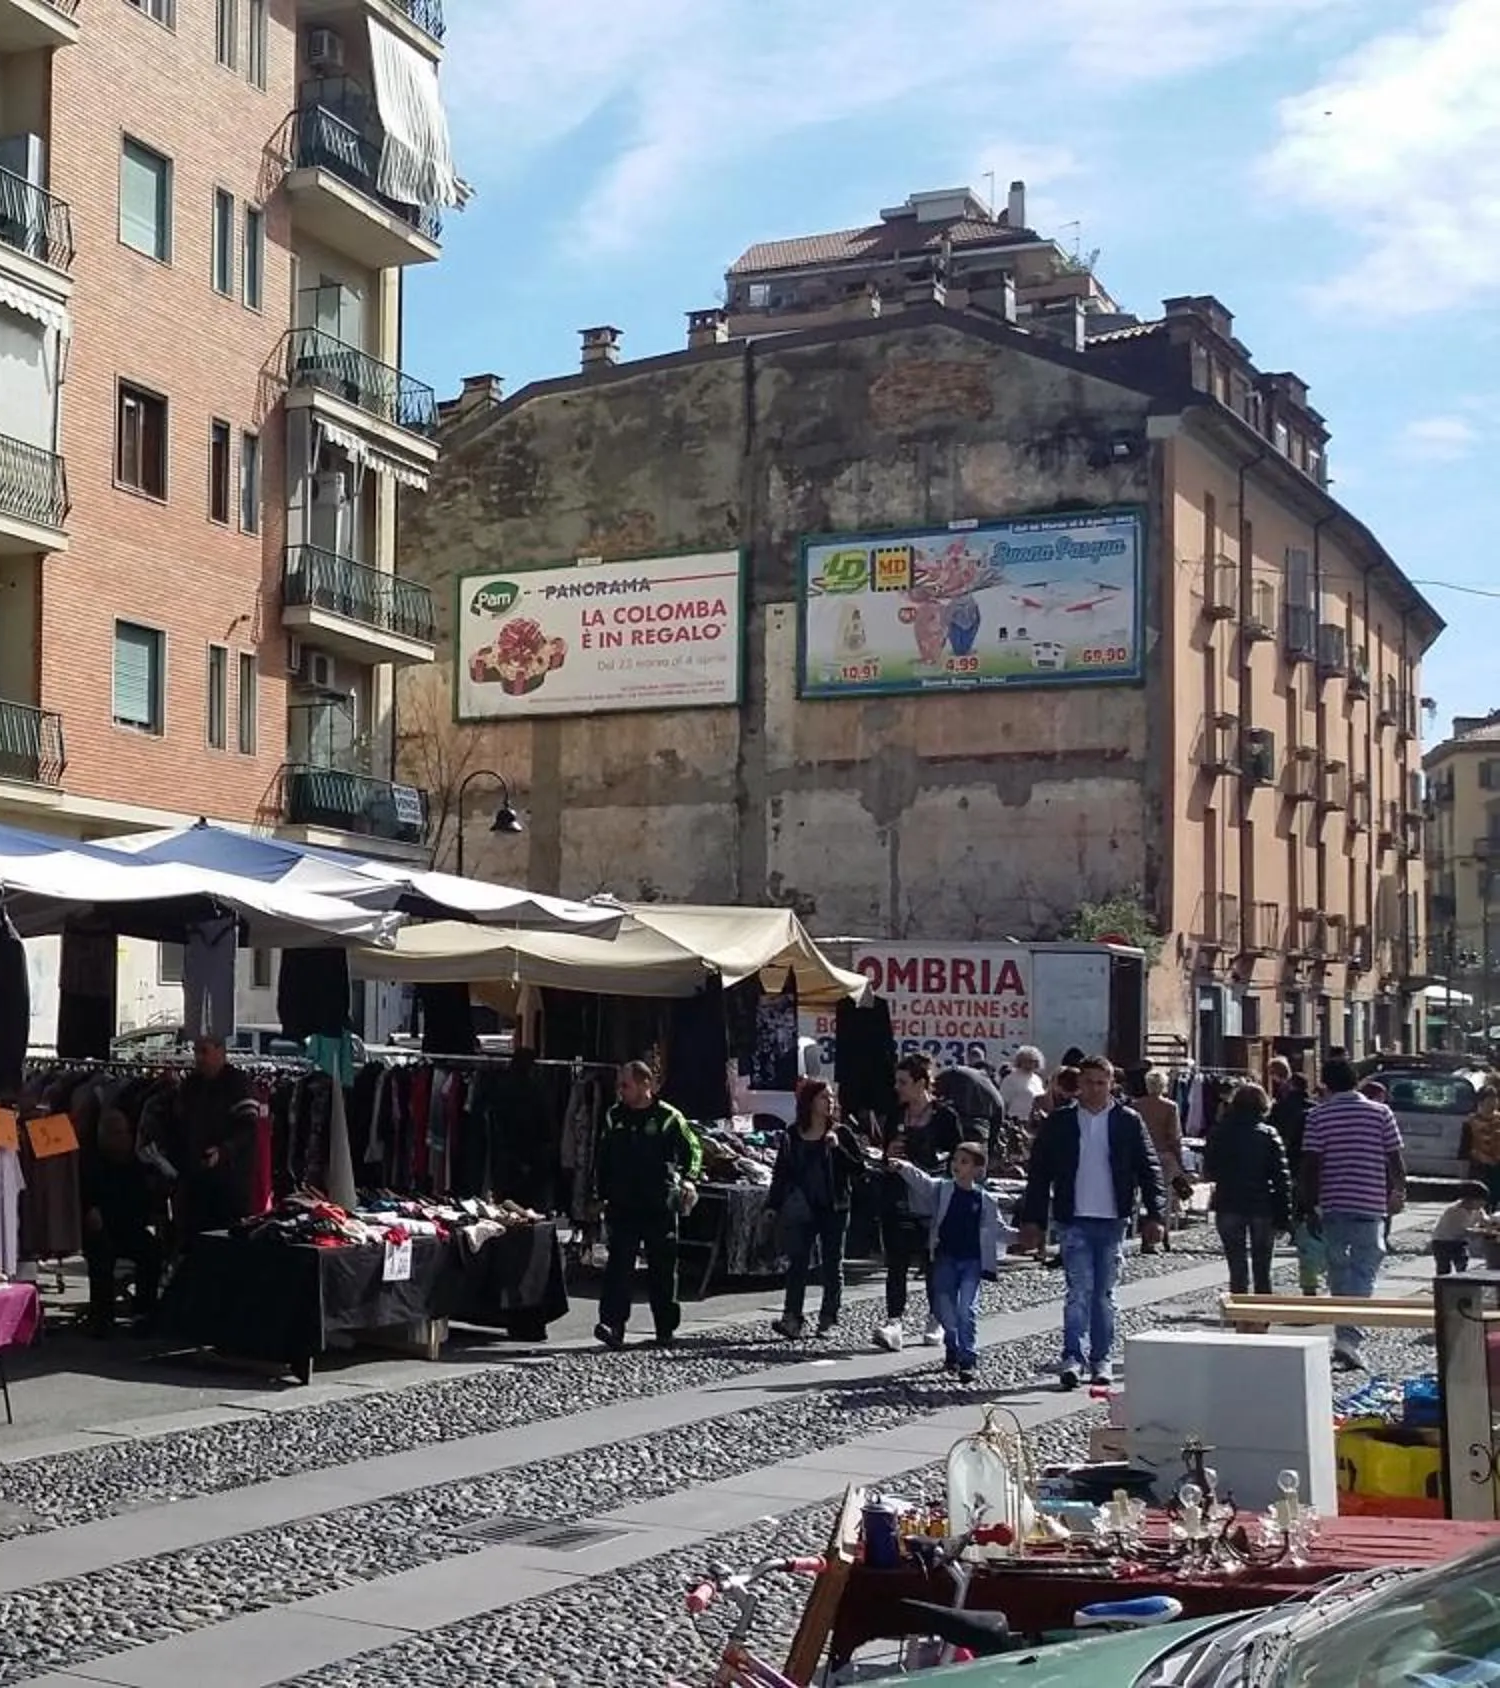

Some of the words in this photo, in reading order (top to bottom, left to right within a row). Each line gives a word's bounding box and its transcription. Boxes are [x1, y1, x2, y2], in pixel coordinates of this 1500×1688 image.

[879, 558, 907, 576] MD
[545, 577, 651, 600] PANORAMA
[478, 592, 512, 608] Pam
[581, 610, 605, 627] LA
[613, 599, 728, 625] COLOMBA
[581, 628, 592, 649] È
[599, 631, 623, 649] IN
[935, 1021, 1006, 1039] LOCALI
